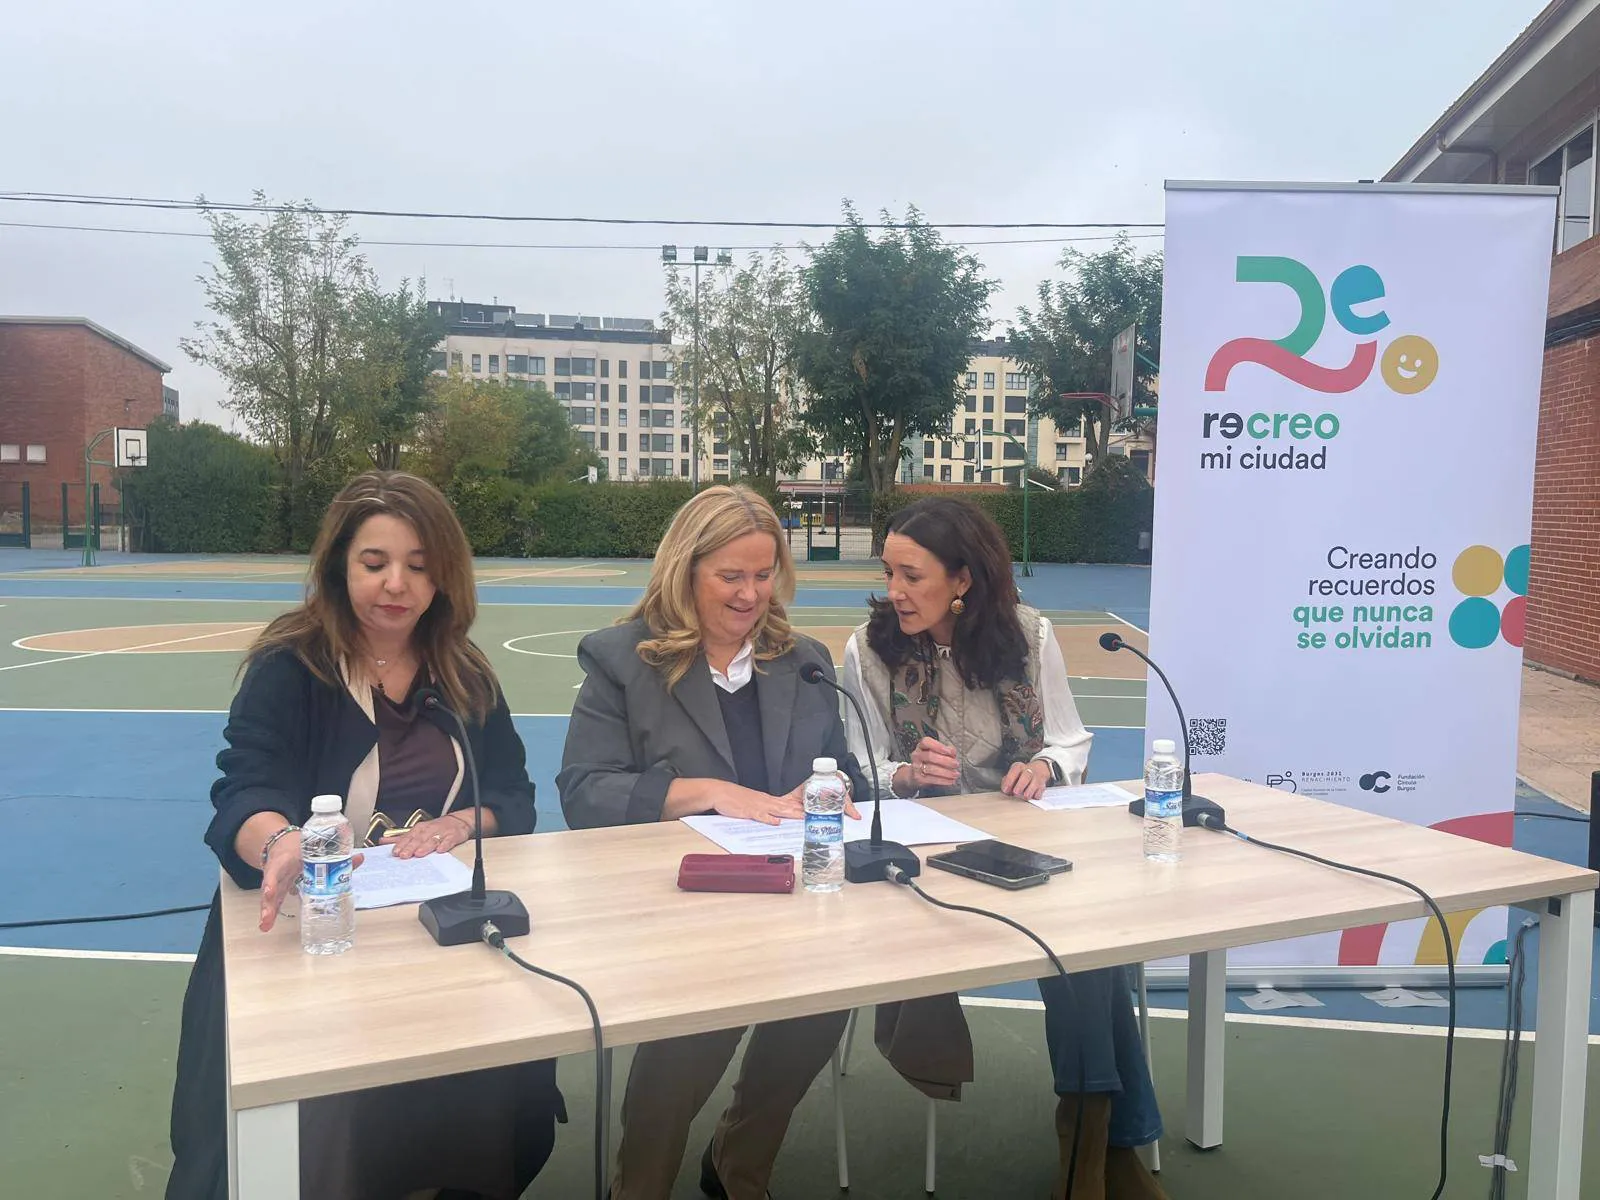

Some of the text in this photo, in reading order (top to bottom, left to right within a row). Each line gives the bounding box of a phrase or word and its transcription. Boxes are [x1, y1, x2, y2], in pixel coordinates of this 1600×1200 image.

[1202, 412, 1340, 440] recreo
[1200, 445, 1327, 470] mi ciudad
[1327, 545, 1437, 570] Creando
[1308, 571, 1436, 596] recuerdos
[1292, 602, 1433, 628] que nunca
[1296, 624, 1432, 649] se olvidan
